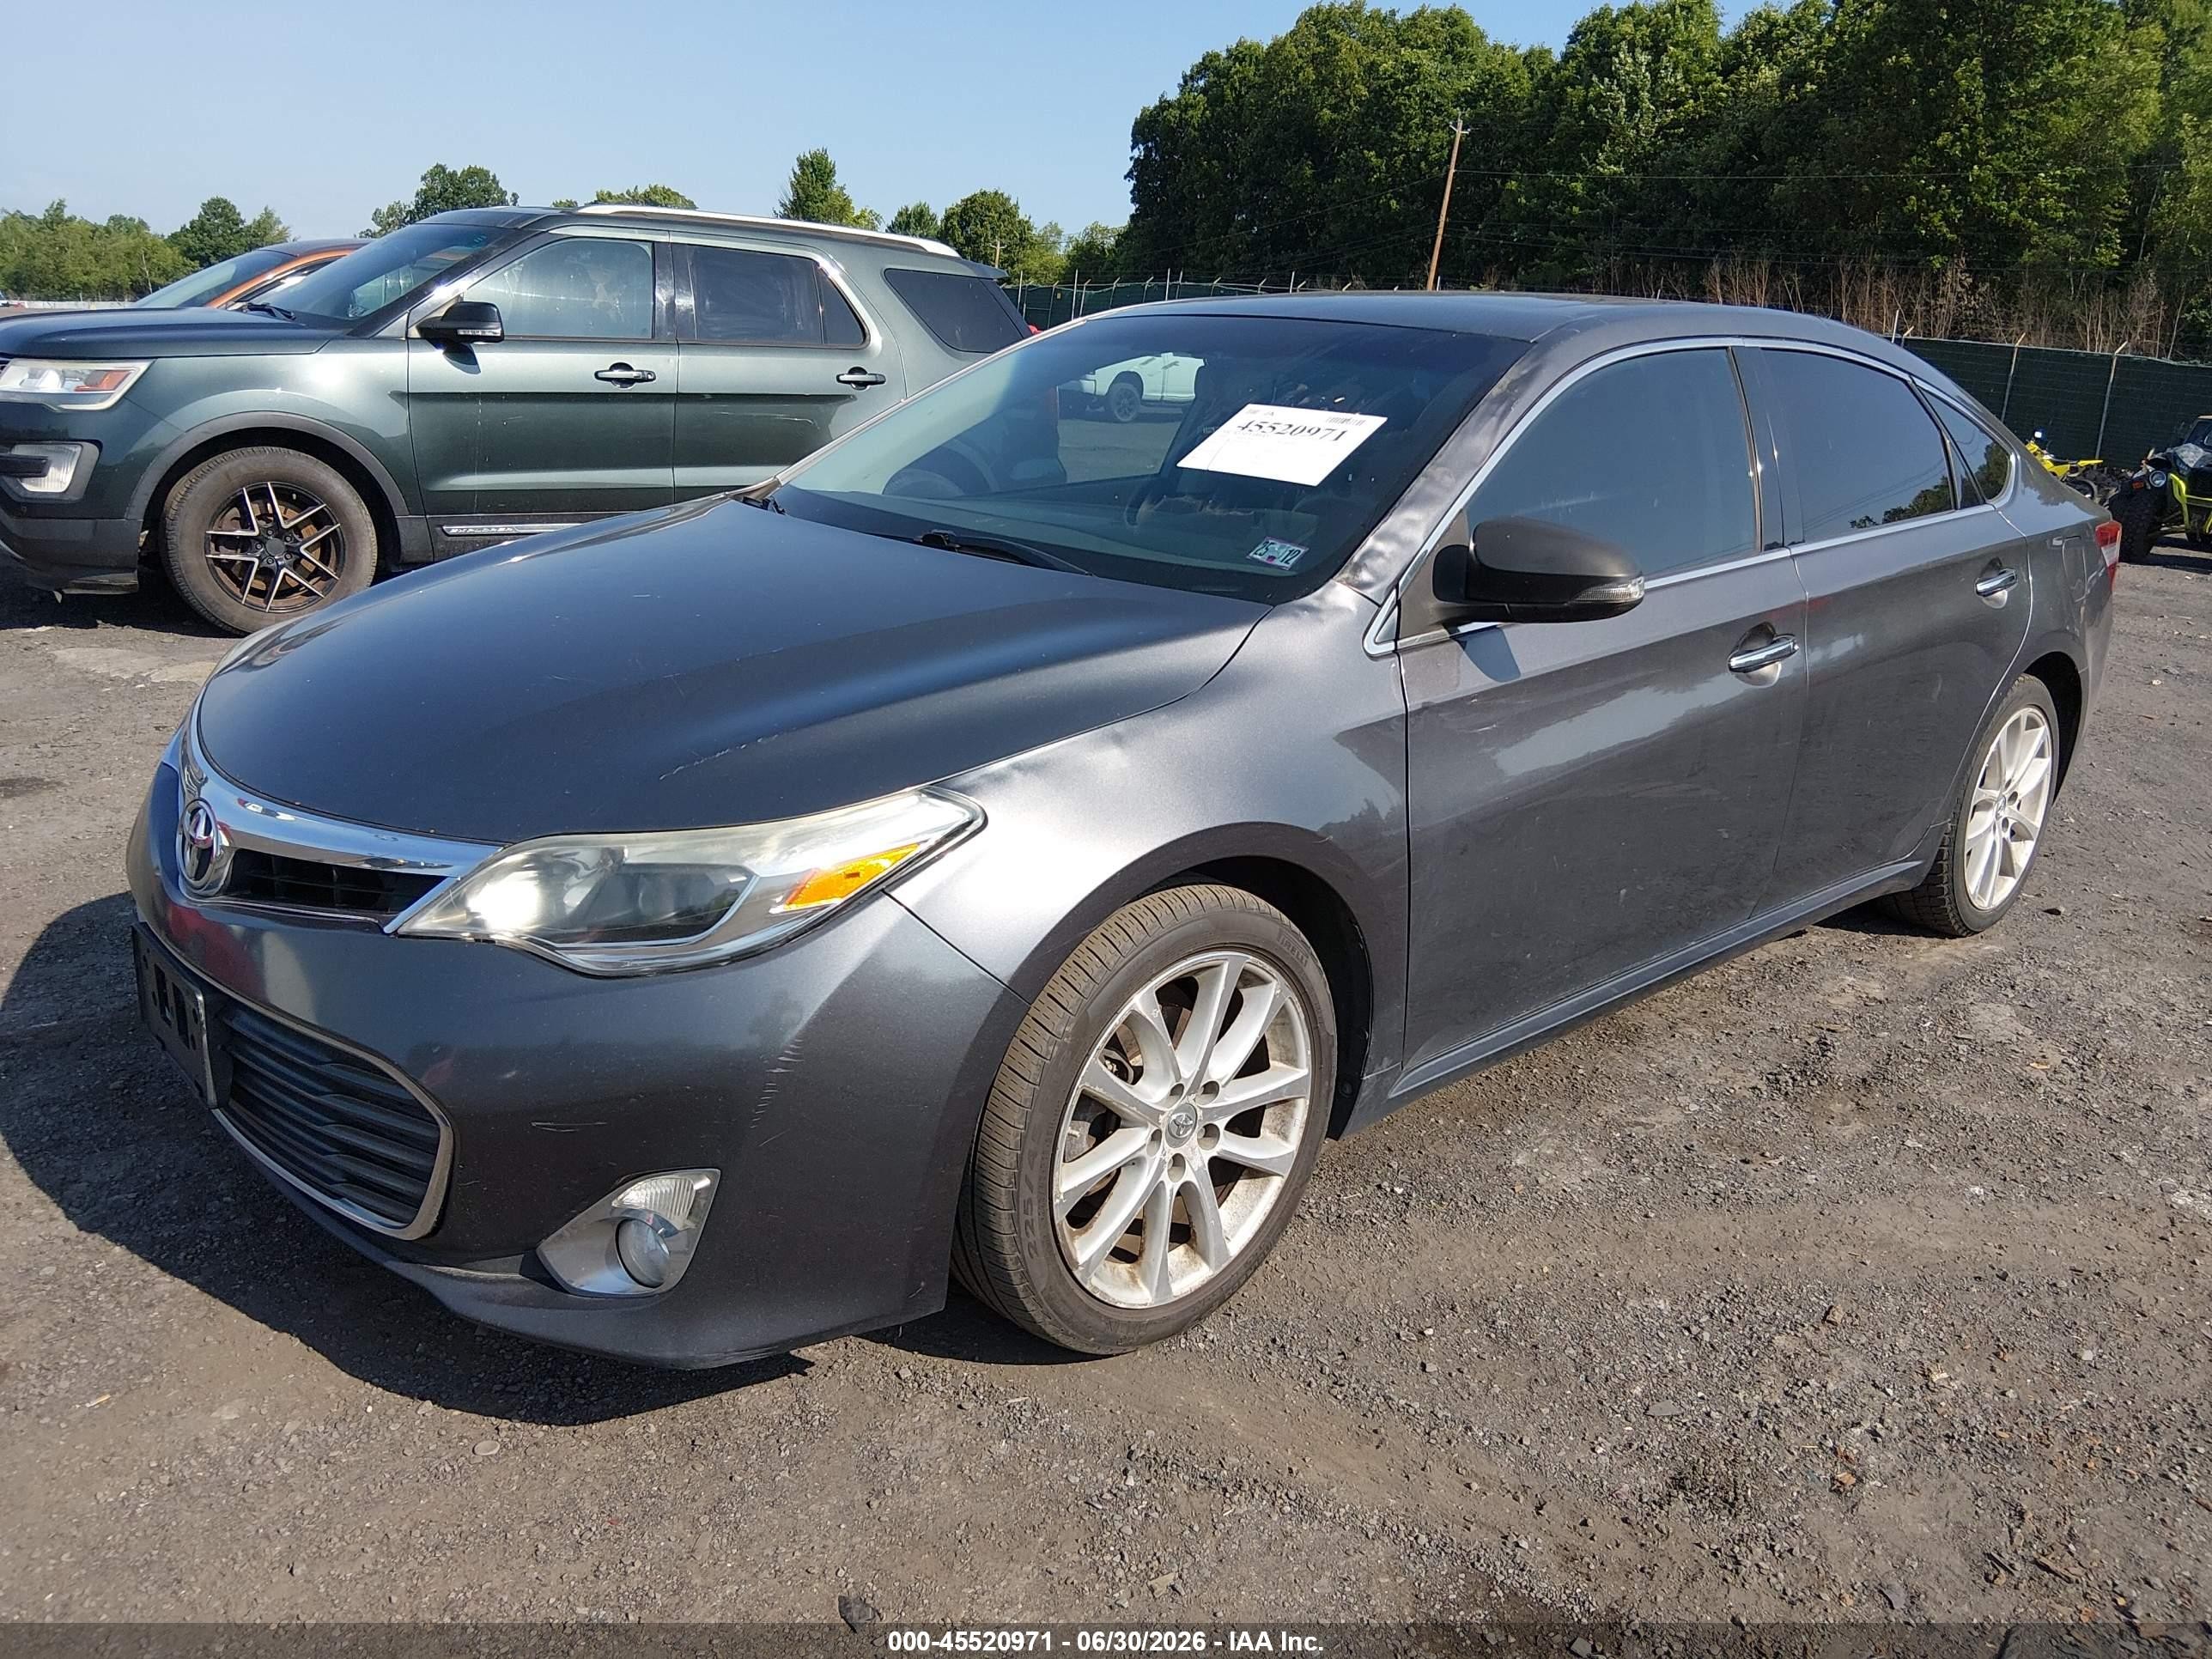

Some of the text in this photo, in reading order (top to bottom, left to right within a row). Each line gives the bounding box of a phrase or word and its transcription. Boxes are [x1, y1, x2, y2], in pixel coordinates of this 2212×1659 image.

[1237, 420, 1348, 441] 45520971
[1254, 541, 1302, 564] 25 12
